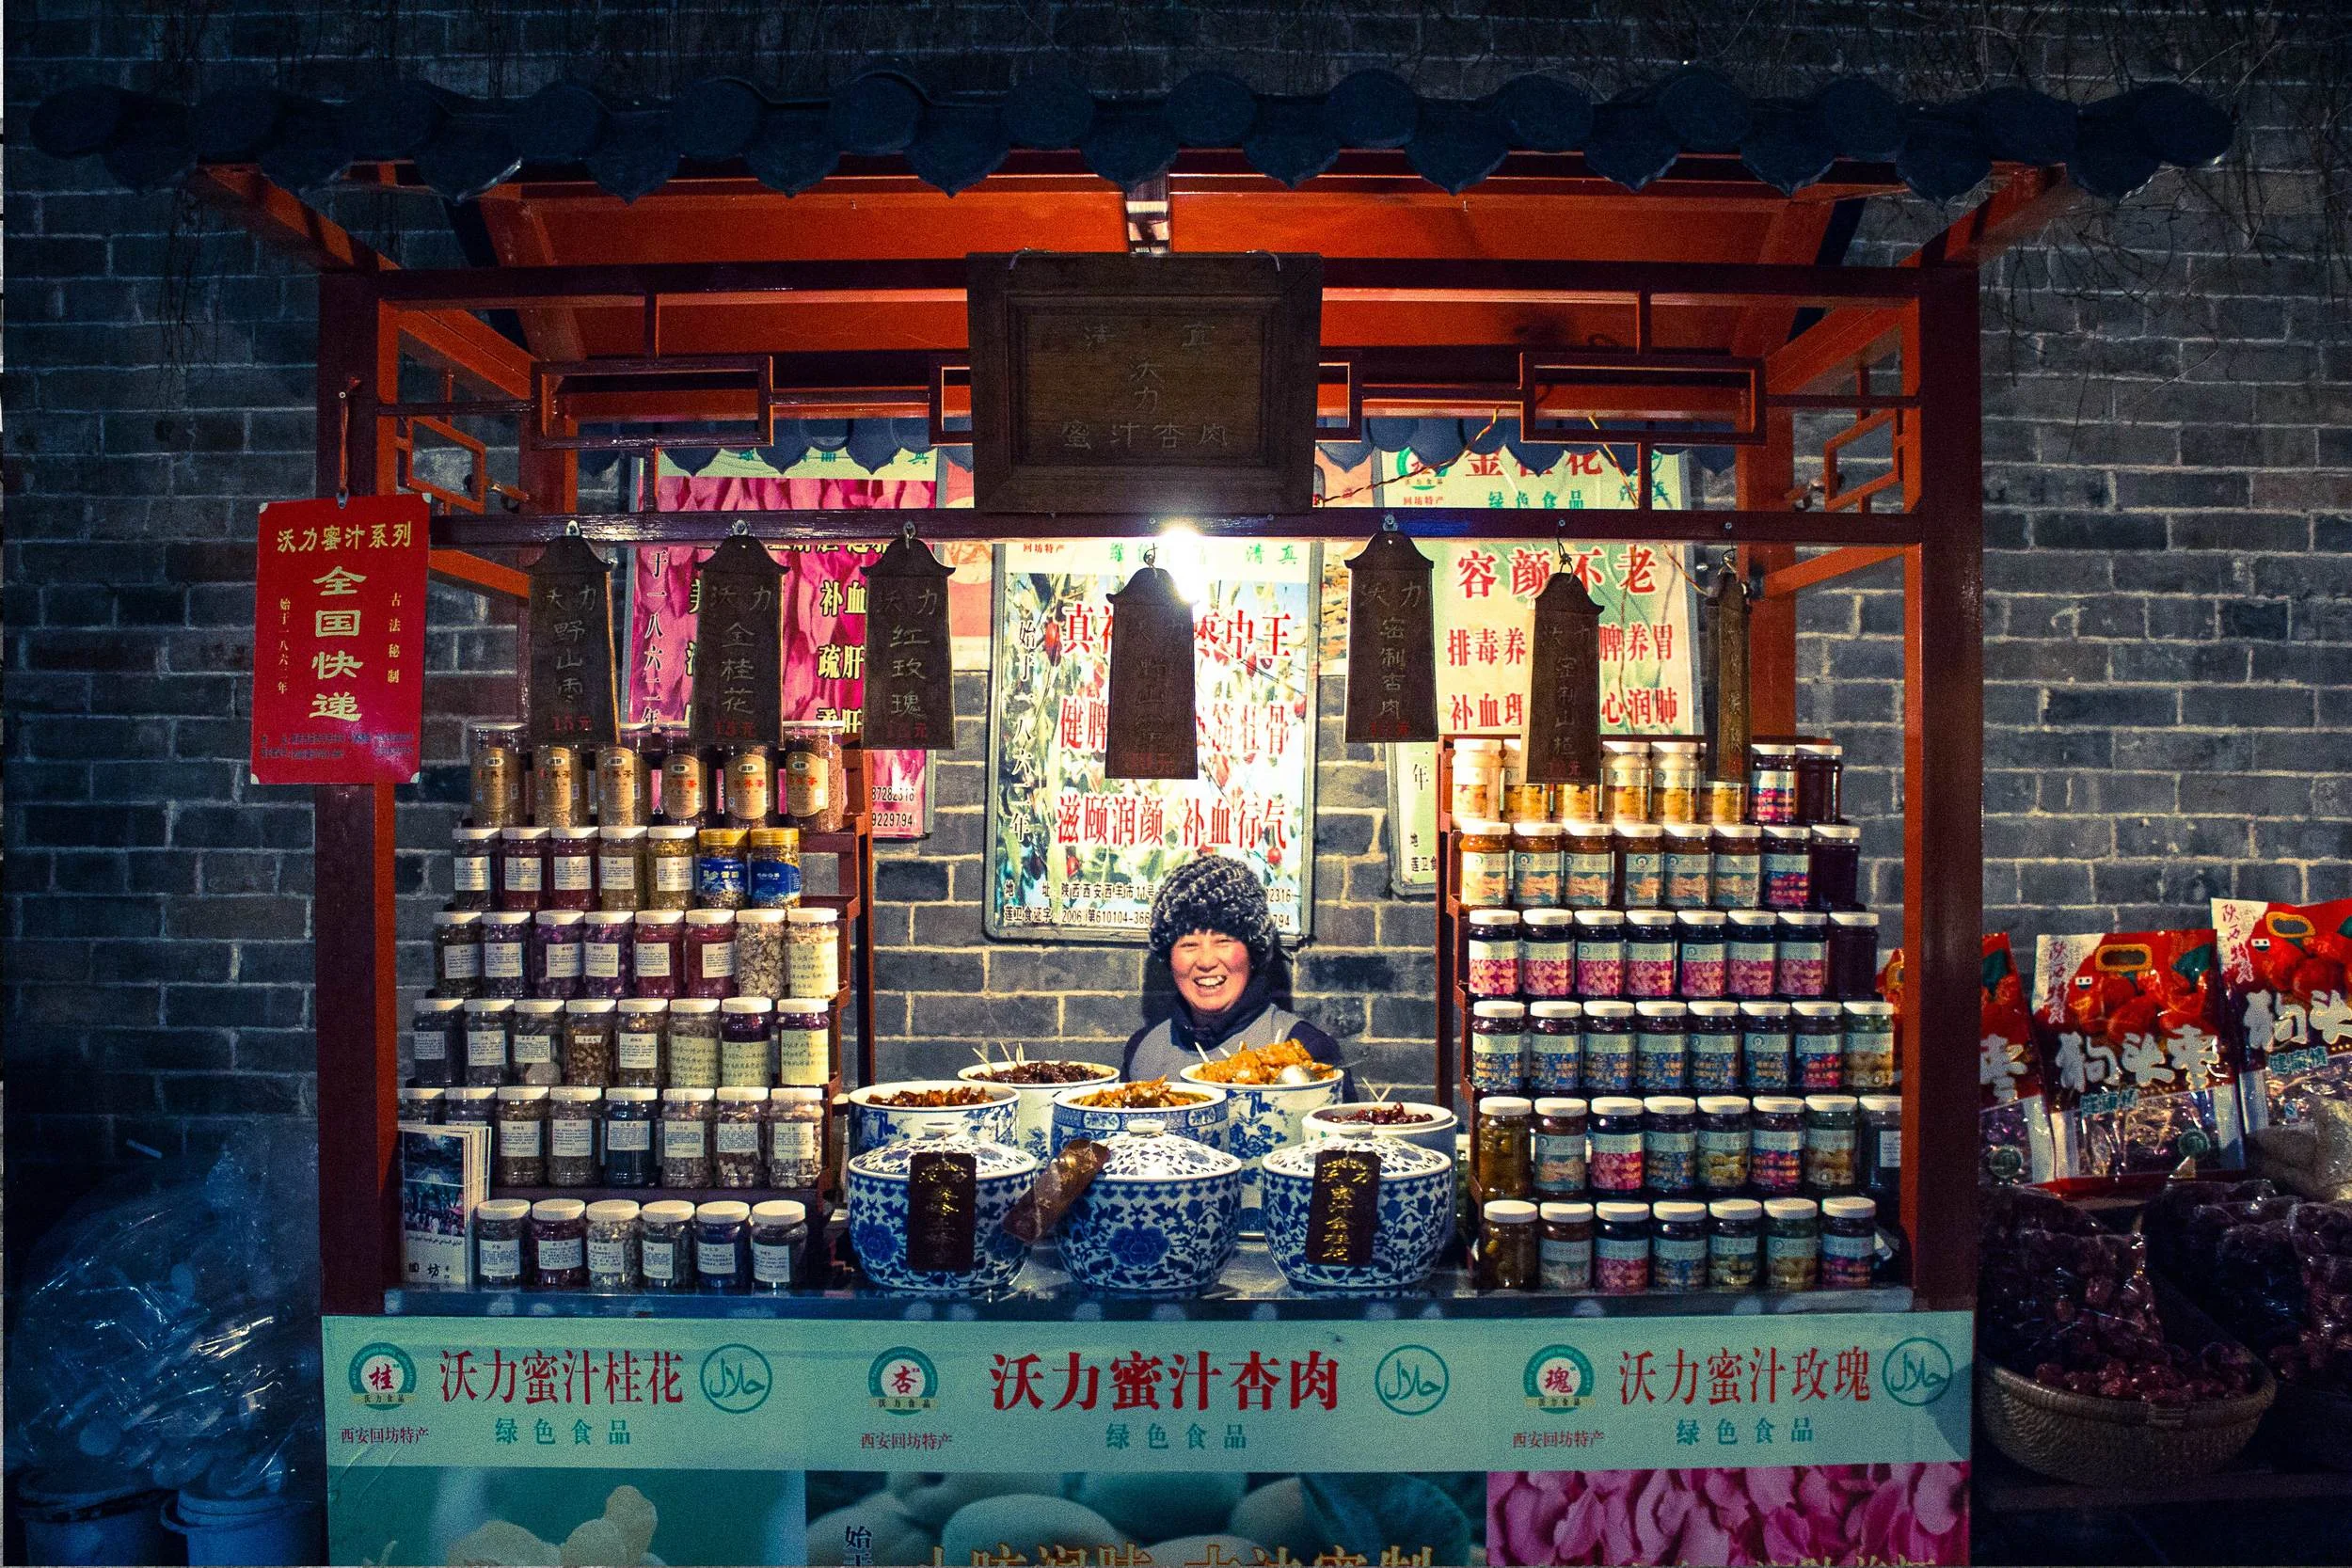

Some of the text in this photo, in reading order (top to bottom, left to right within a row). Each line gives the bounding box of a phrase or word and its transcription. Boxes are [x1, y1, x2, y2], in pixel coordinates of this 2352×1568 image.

[1061, 420, 1229, 451] 蜜汁杏肉
[277, 520, 413, 553] 沃力蜜汁系列
[1246, 544, 1298, 565] 清真
[1457, 549, 1657, 600] 容颜不老
[309, 565, 368, 722] 全国快递
[388, 592, 402, 684] 古法秘制
[720, 620, 756, 715] 金桂花
[888, 624, 931, 721] 红玫瑰
[1057, 793, 1164, 847] 滋颐润颜
[1183, 797, 1287, 850] 补血行气
[369, 1363, 394, 1391] 桂
[439, 1349, 685, 1406] 沃力蜜汁桂花
[891, 1365, 917, 1394] 杏
[988, 1349, 1340, 1412] 沃力蜜汁杏肉
[1545, 1367, 1573, 1394] 瑰
[1618, 1345, 1871, 1406] 沃力蜜汁玫瑰
[342, 1426, 429, 1444] 西安回坊特产
[495, 1418, 631, 1446] 绿色食品
[862, 1432, 952, 1449] 西安回坊特产
[1105, 1422, 1248, 1450] 绿色食品
[1513, 1430, 1604, 1448] 西安回坊特产
[1676, 1418, 1814, 1446] 绿色食品
